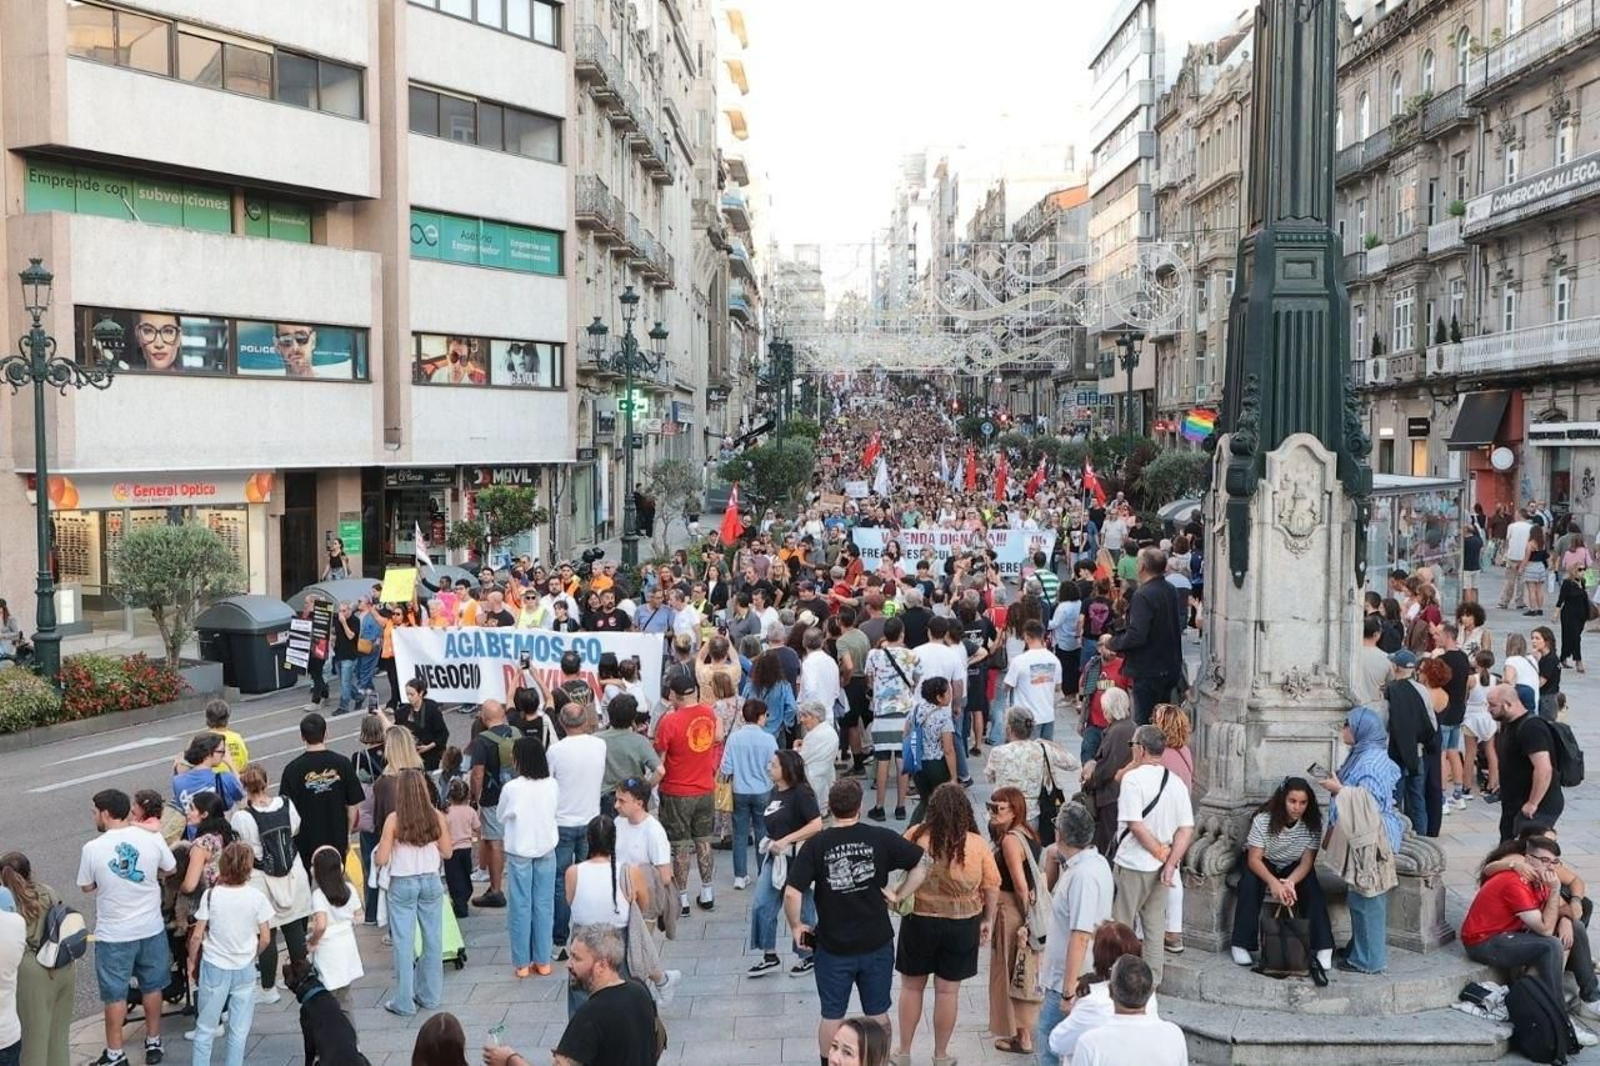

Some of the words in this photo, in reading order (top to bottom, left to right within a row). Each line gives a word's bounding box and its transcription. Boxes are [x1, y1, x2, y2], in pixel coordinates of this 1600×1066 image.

[29, 168, 99, 191] Emprende
[104, 182, 128, 196] con
[138, 186, 230, 211] subvenciones
[240, 344, 276, 354] POLICE
[133, 483, 178, 497] General
[181, 482, 216, 499] Optica
[444, 631, 564, 663] ACABEMOS
[414, 663, 481, 691] NEGOCIO
[1013, 953, 1027, 989] fnac
